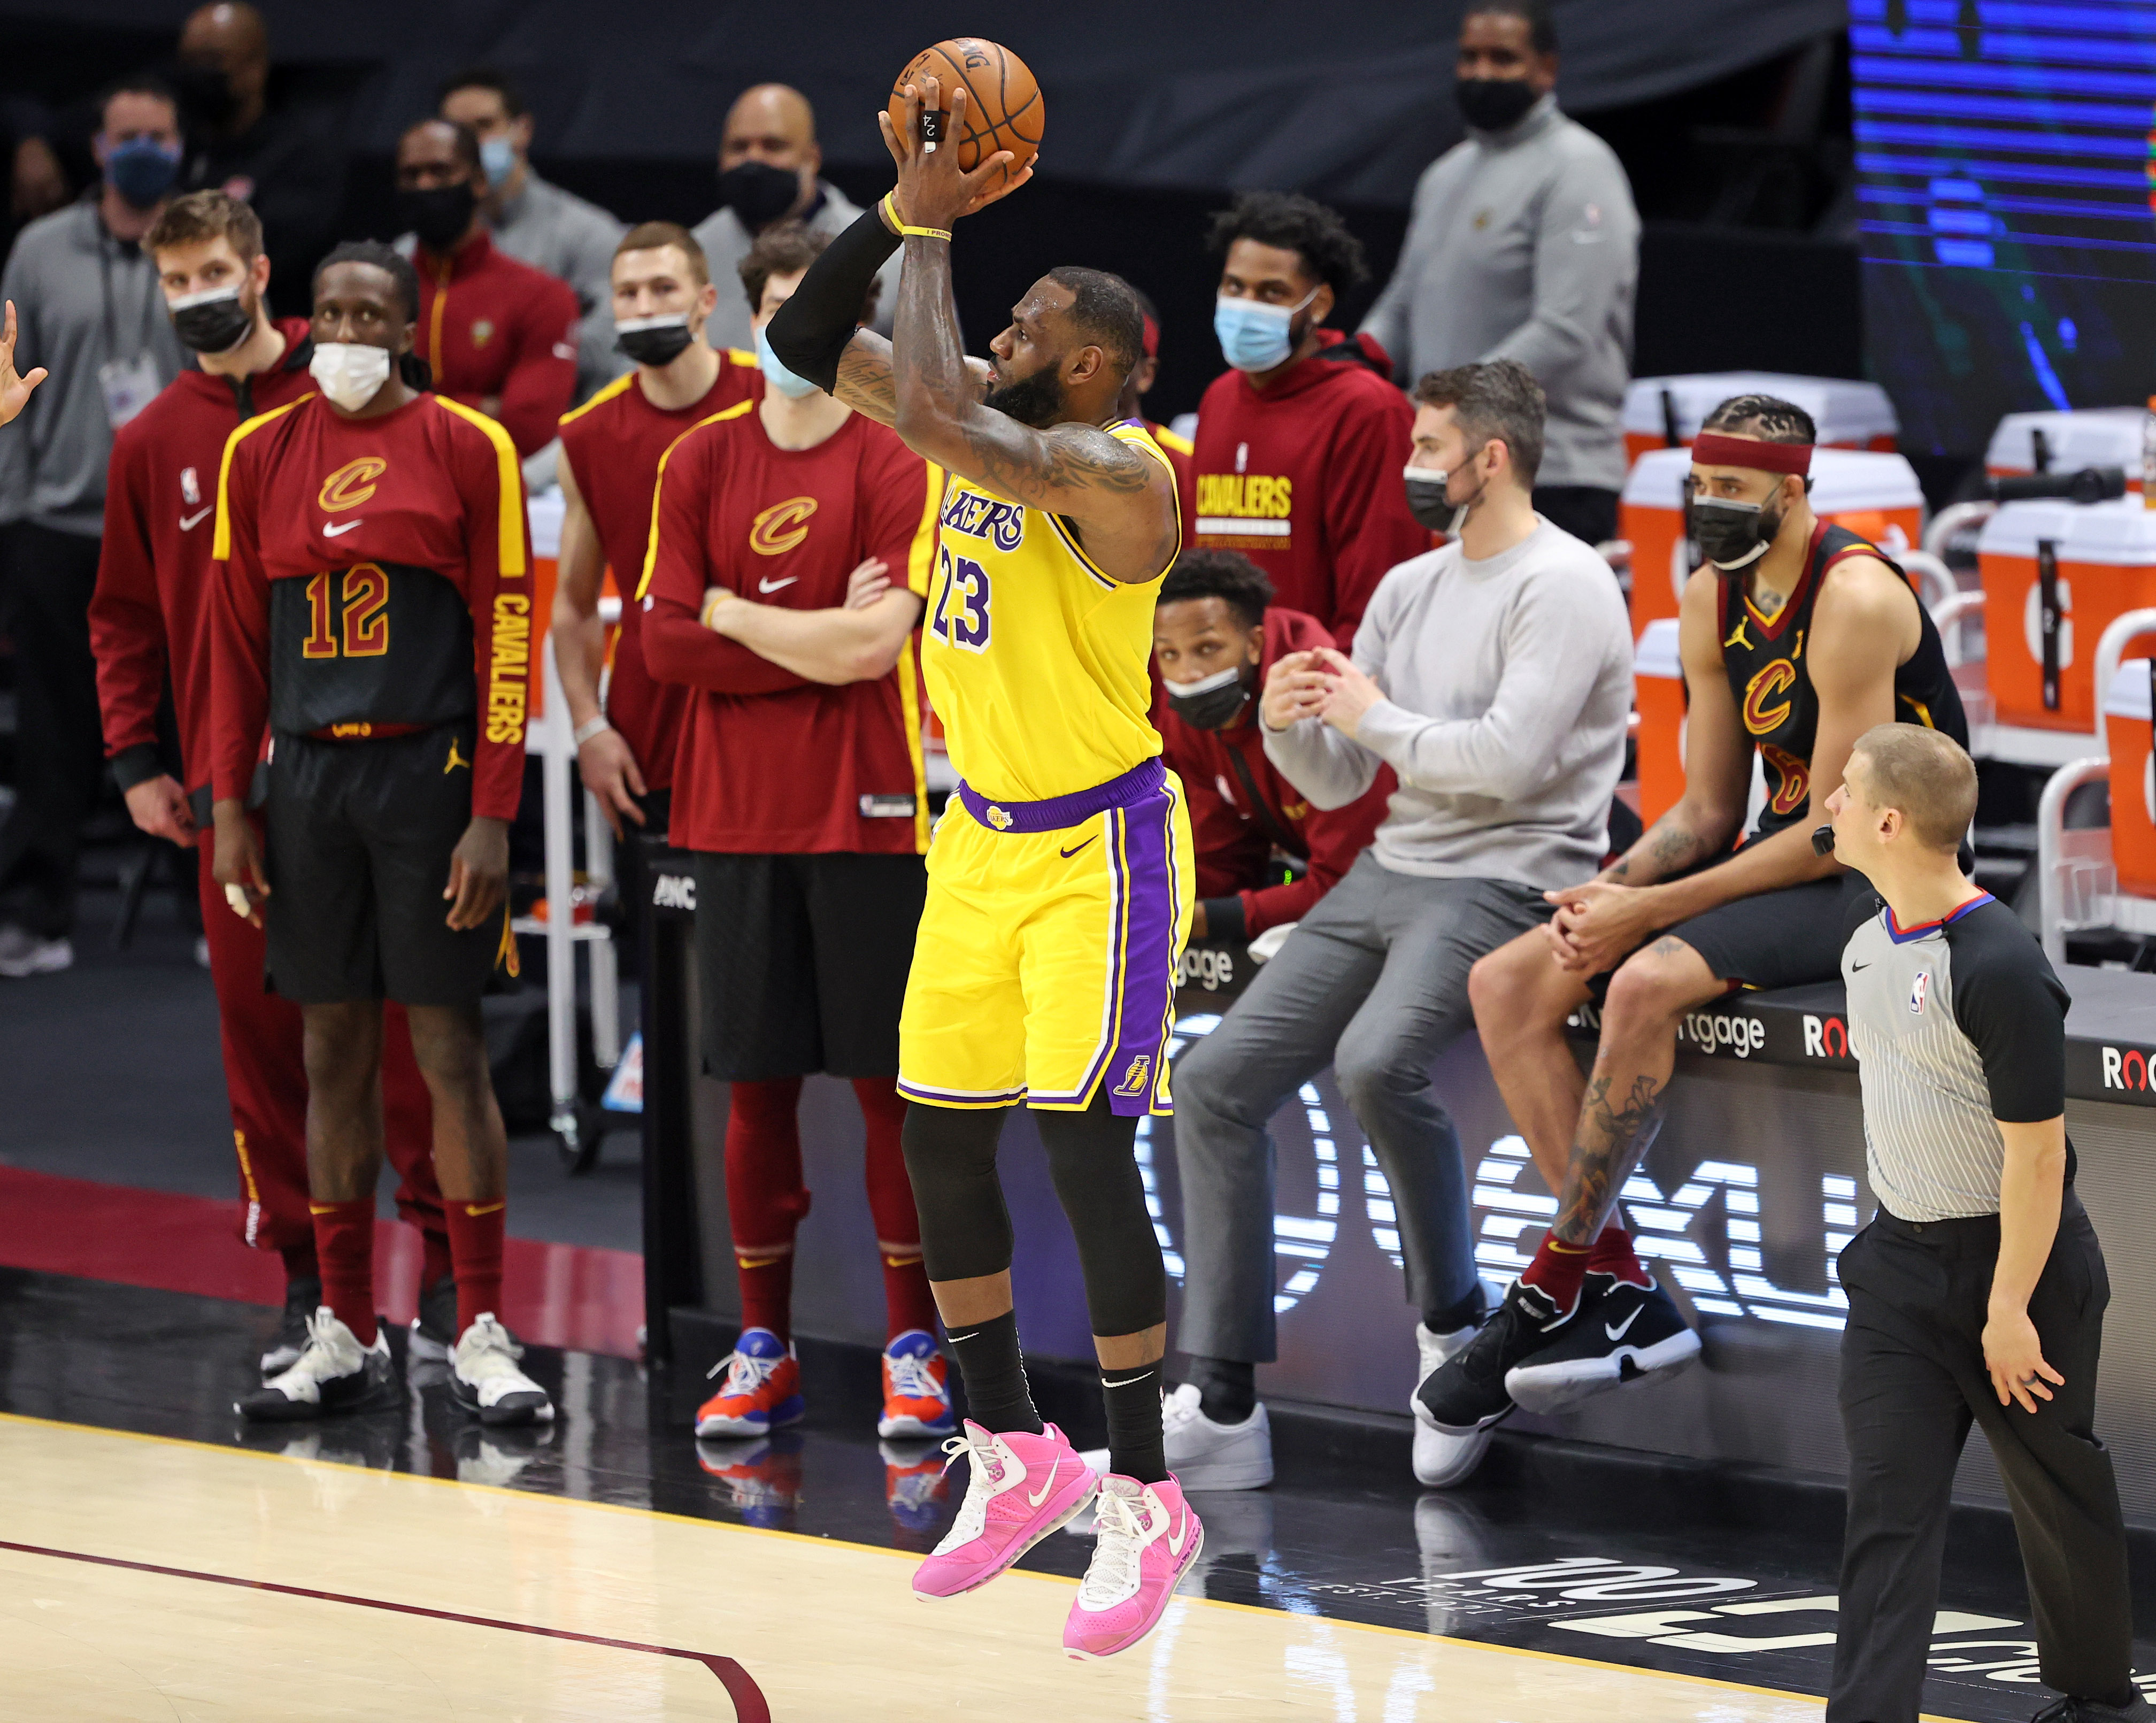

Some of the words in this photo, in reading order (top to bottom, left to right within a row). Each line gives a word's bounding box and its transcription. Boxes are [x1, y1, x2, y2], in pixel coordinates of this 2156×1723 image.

[1196, 473, 1292, 518] CAVALIERS
[303, 563, 389, 658] 12
[929, 540, 992, 655] 23
[485, 593, 531, 744] CAVALIERS
[1380, 1576, 1577, 1608] YEARS
[1433, 1557, 1758, 1601] 100
[1396, 1598, 1504, 1614] 1921
